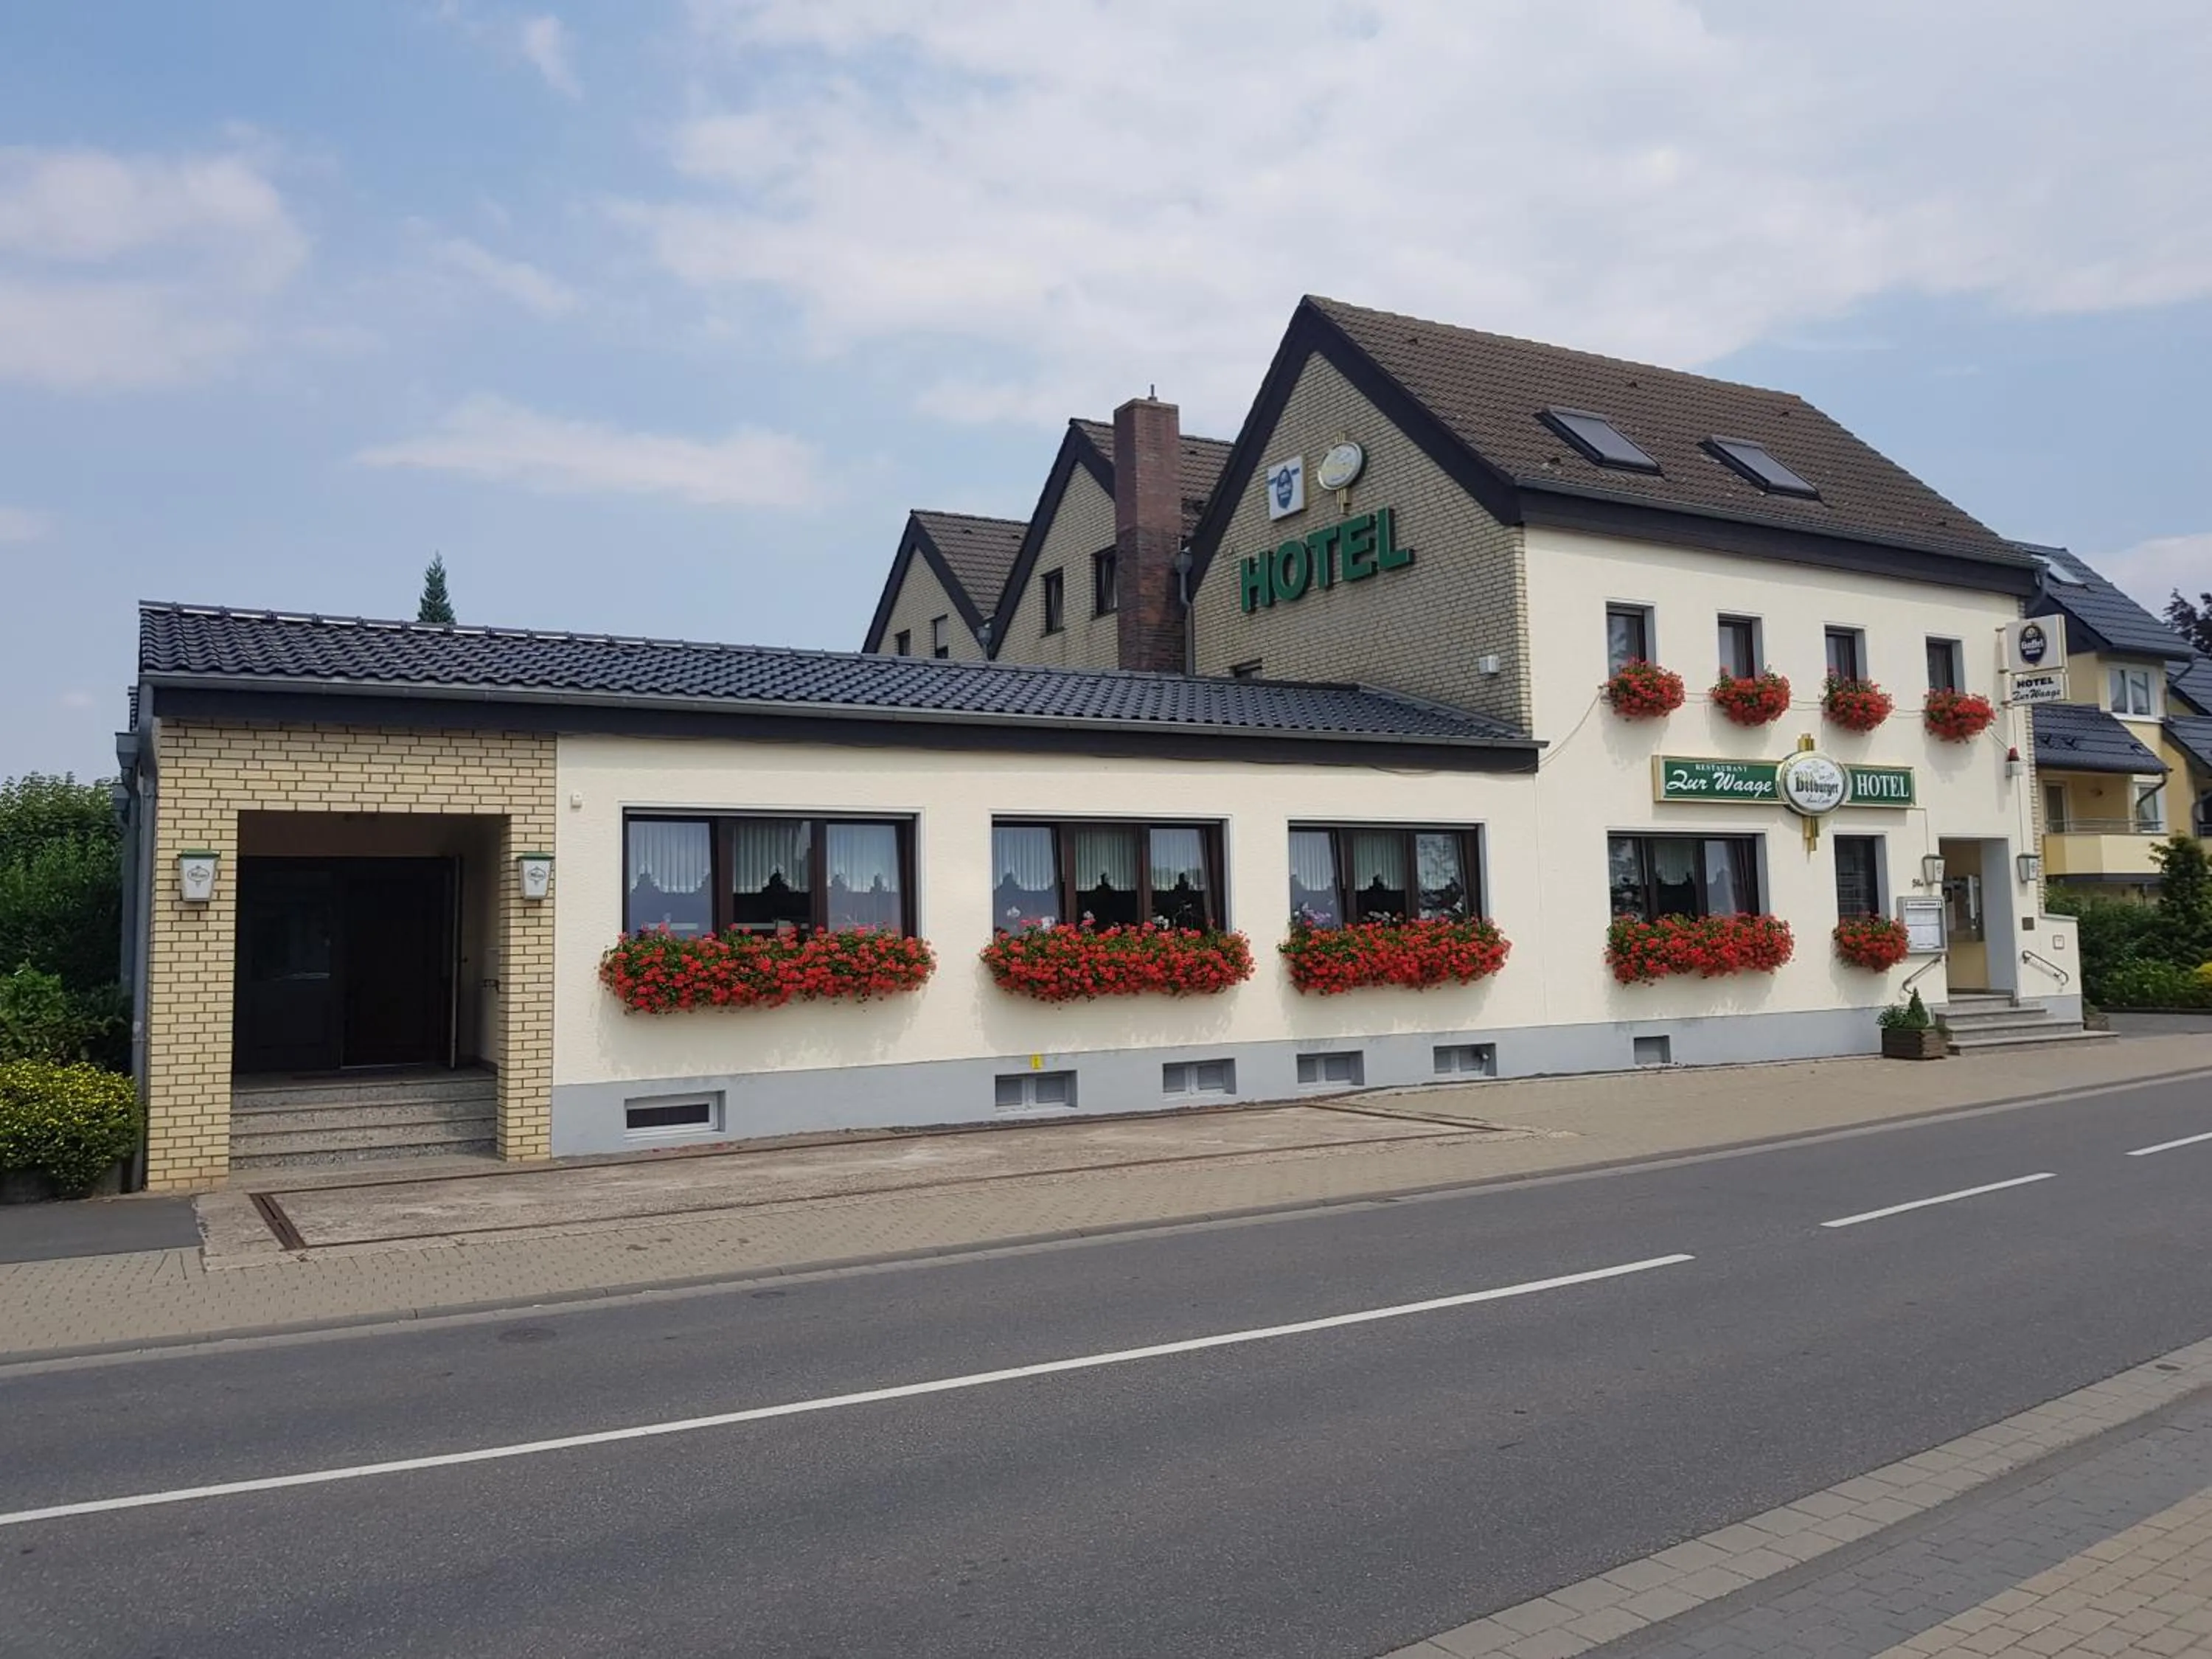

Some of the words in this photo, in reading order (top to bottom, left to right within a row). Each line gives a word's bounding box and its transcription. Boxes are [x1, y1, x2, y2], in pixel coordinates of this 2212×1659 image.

[1240, 505, 1413, 613] HOTEL
[2017, 677, 2053, 688] HOTEL
[2012, 691, 2029, 700] Zur
[2029, 689, 2061, 700] Waage
[1695, 764, 1747, 773] RESTAURANT
[1666, 769, 1708, 790] Zur
[1713, 771, 1773, 798] Waage
[1856, 774, 1909, 797] HOTEL
